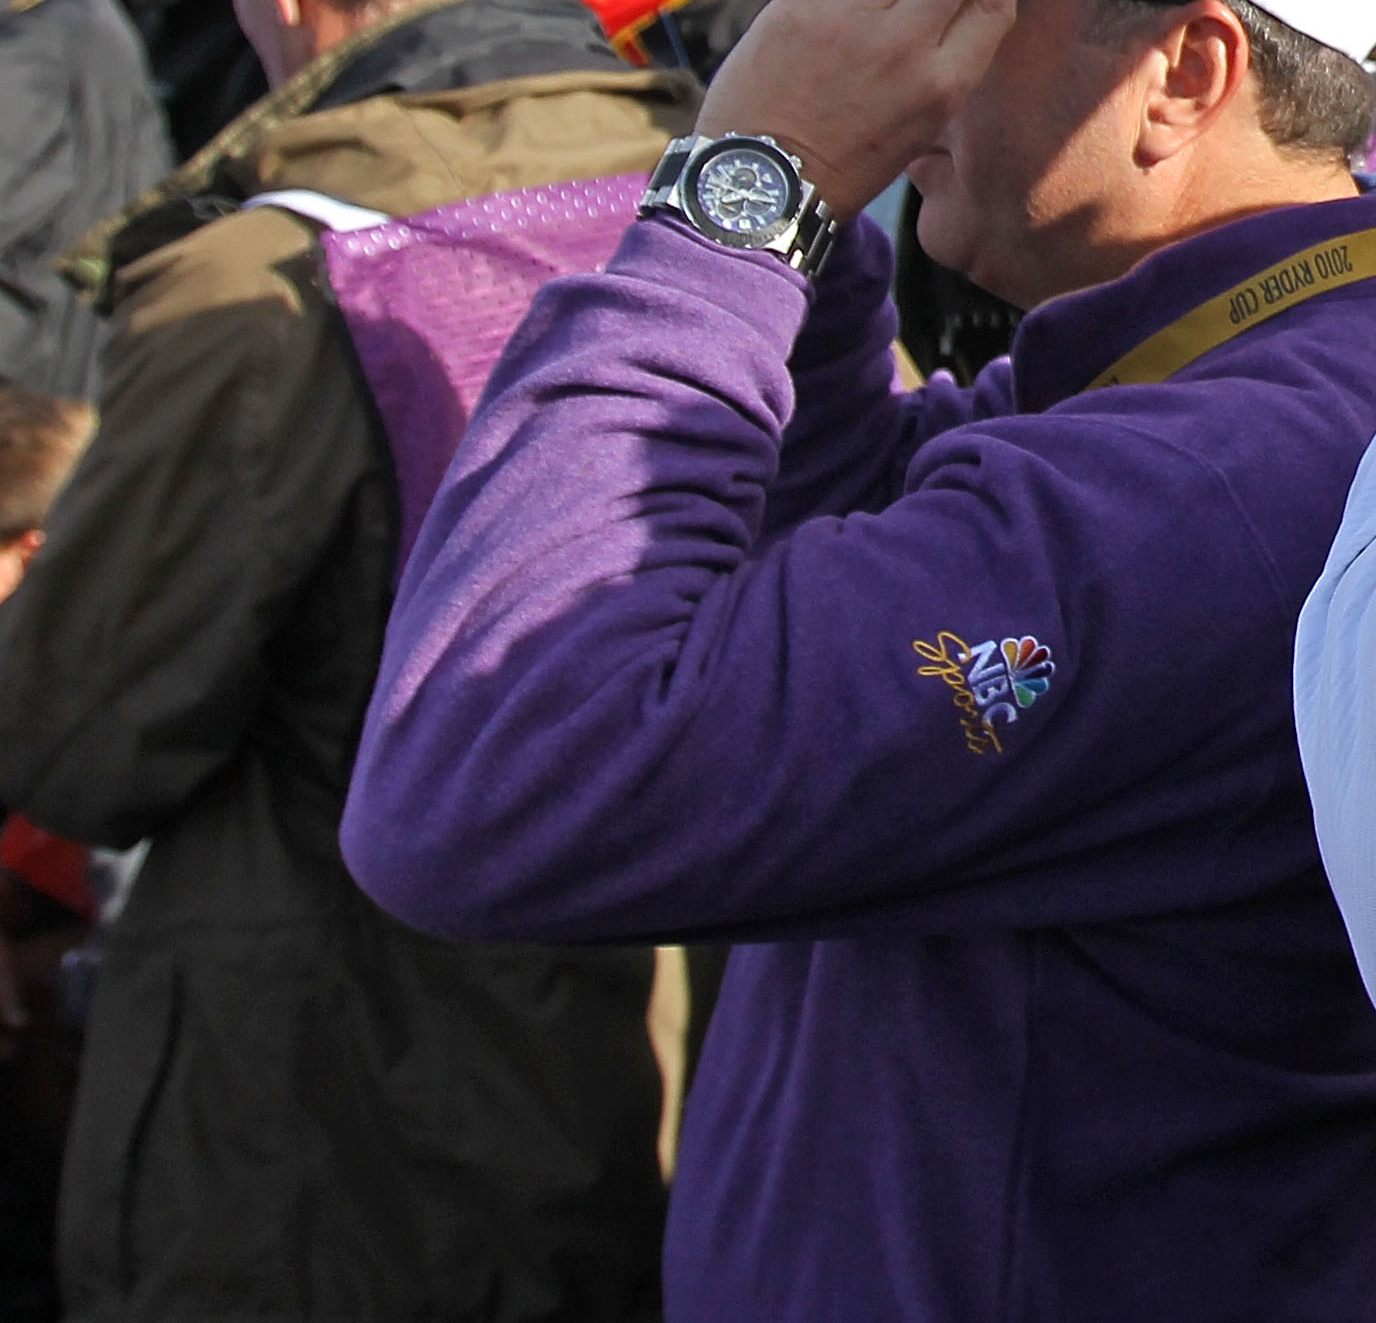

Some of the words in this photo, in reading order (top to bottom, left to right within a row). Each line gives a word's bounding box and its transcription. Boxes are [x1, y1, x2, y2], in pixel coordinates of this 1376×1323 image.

[1259, 259, 1315, 304] RYDER
[1314, 245, 1353, 279] 2010
[1229, 288, 1259, 325] CUP
[957, 640, 1018, 724] NBC
